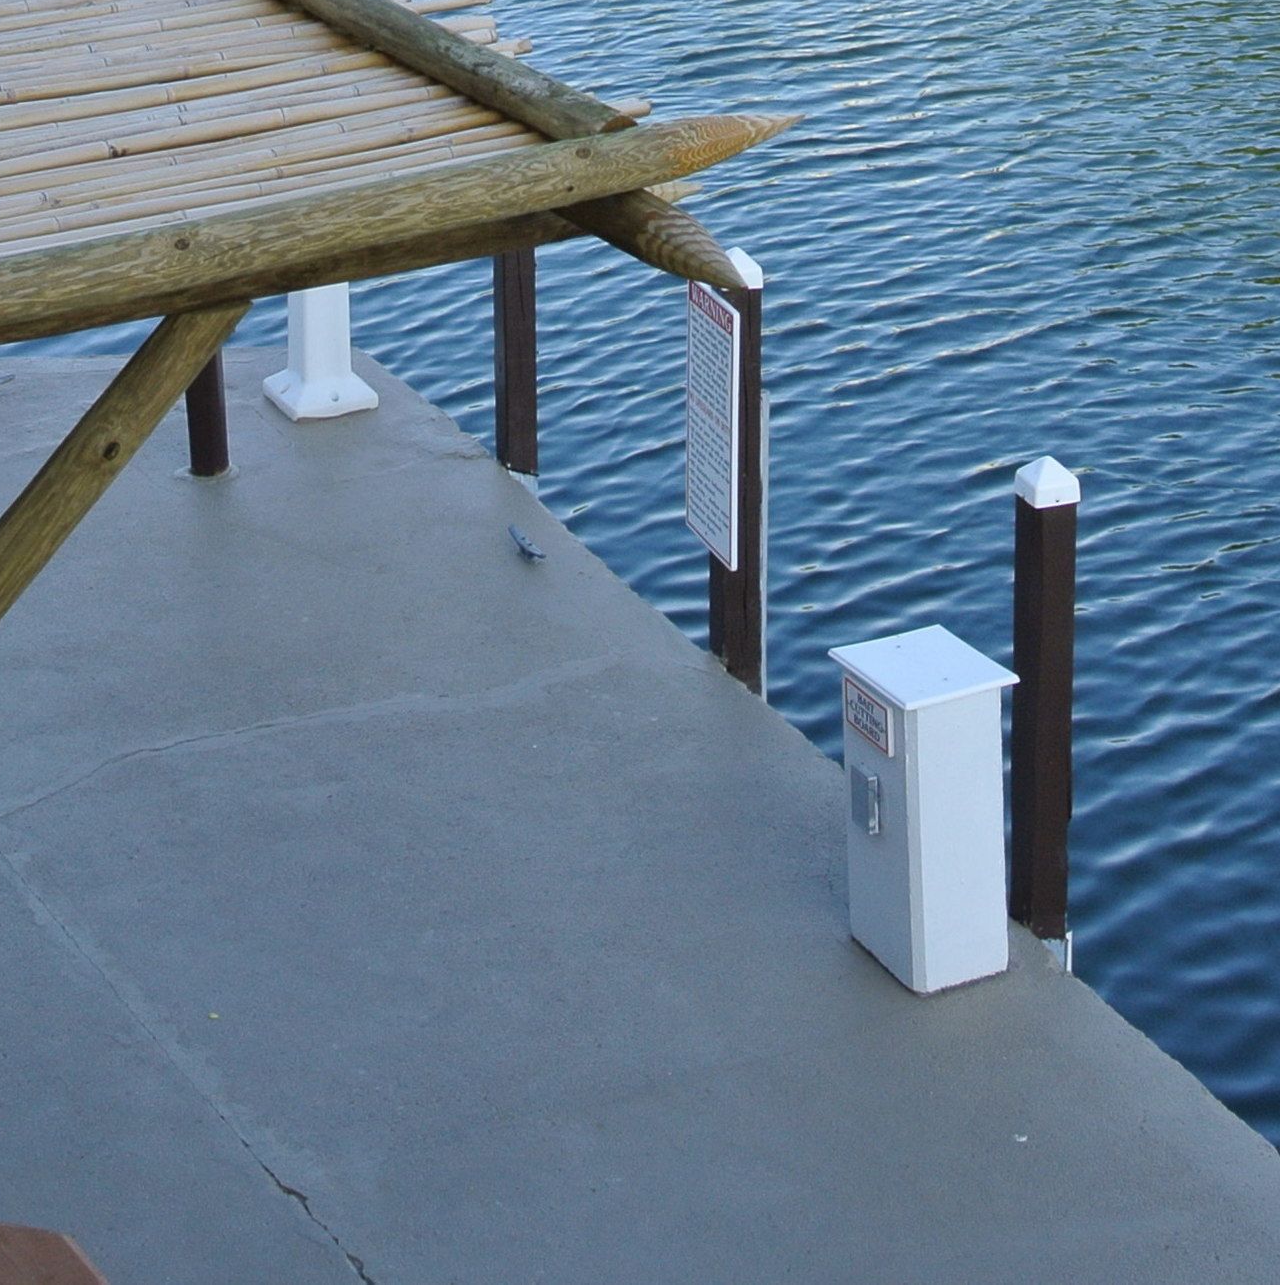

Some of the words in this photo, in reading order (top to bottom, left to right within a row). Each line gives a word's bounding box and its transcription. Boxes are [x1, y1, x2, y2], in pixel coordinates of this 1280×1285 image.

[691, 282, 732, 334] WARNING
[857, 692, 874, 715] BAIT
[853, 713, 880, 742] BOARD
